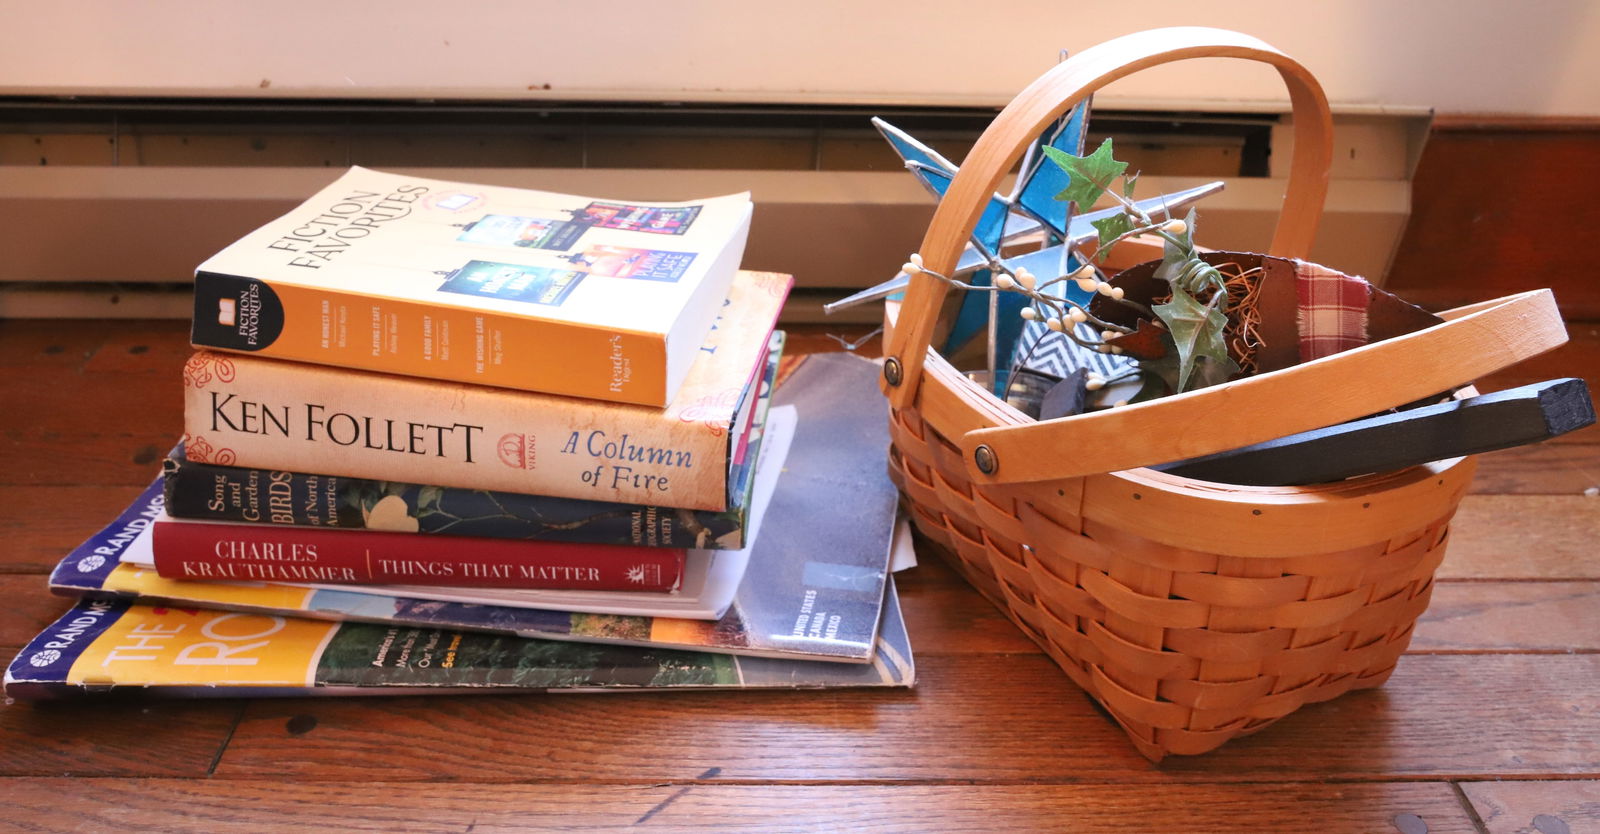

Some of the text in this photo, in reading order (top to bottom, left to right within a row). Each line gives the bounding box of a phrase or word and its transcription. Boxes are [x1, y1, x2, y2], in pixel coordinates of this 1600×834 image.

[267, 190, 380, 252] FICTION
[287, 184, 429, 269] FAVORITES
[239, 290, 250, 336] FICTION
[247, 283, 262, 345] FAVORITES
[609, 335, 623, 392] Reader's
[209, 391, 484, 464] KEN FOLLETT
[528, 434, 537, 471] VIKING
[560, 430, 693, 468] A Column
[208, 474, 227, 511] Song
[228, 482, 241, 507] and
[242, 470, 260, 521] Garden
[269, 470, 295, 524] BIRDS
[581, 465, 669, 491] of Fire
[306, 475, 321, 525] of North
[325, 477, 339, 526] America
[94, 518, 150, 555] RAND
[215, 540, 318, 562] CHARLES
[661, 516, 672, 545] SOCIETY
[182, 560, 357, 581] KRAUTHAMMER
[379, 559, 600, 581] THINGS THAT MATTER
[800, 589, 817, 614] STATES
[44, 616, 98, 650] RAND
[102, 623, 187, 668] THE
[173, 612, 286, 666] RO
